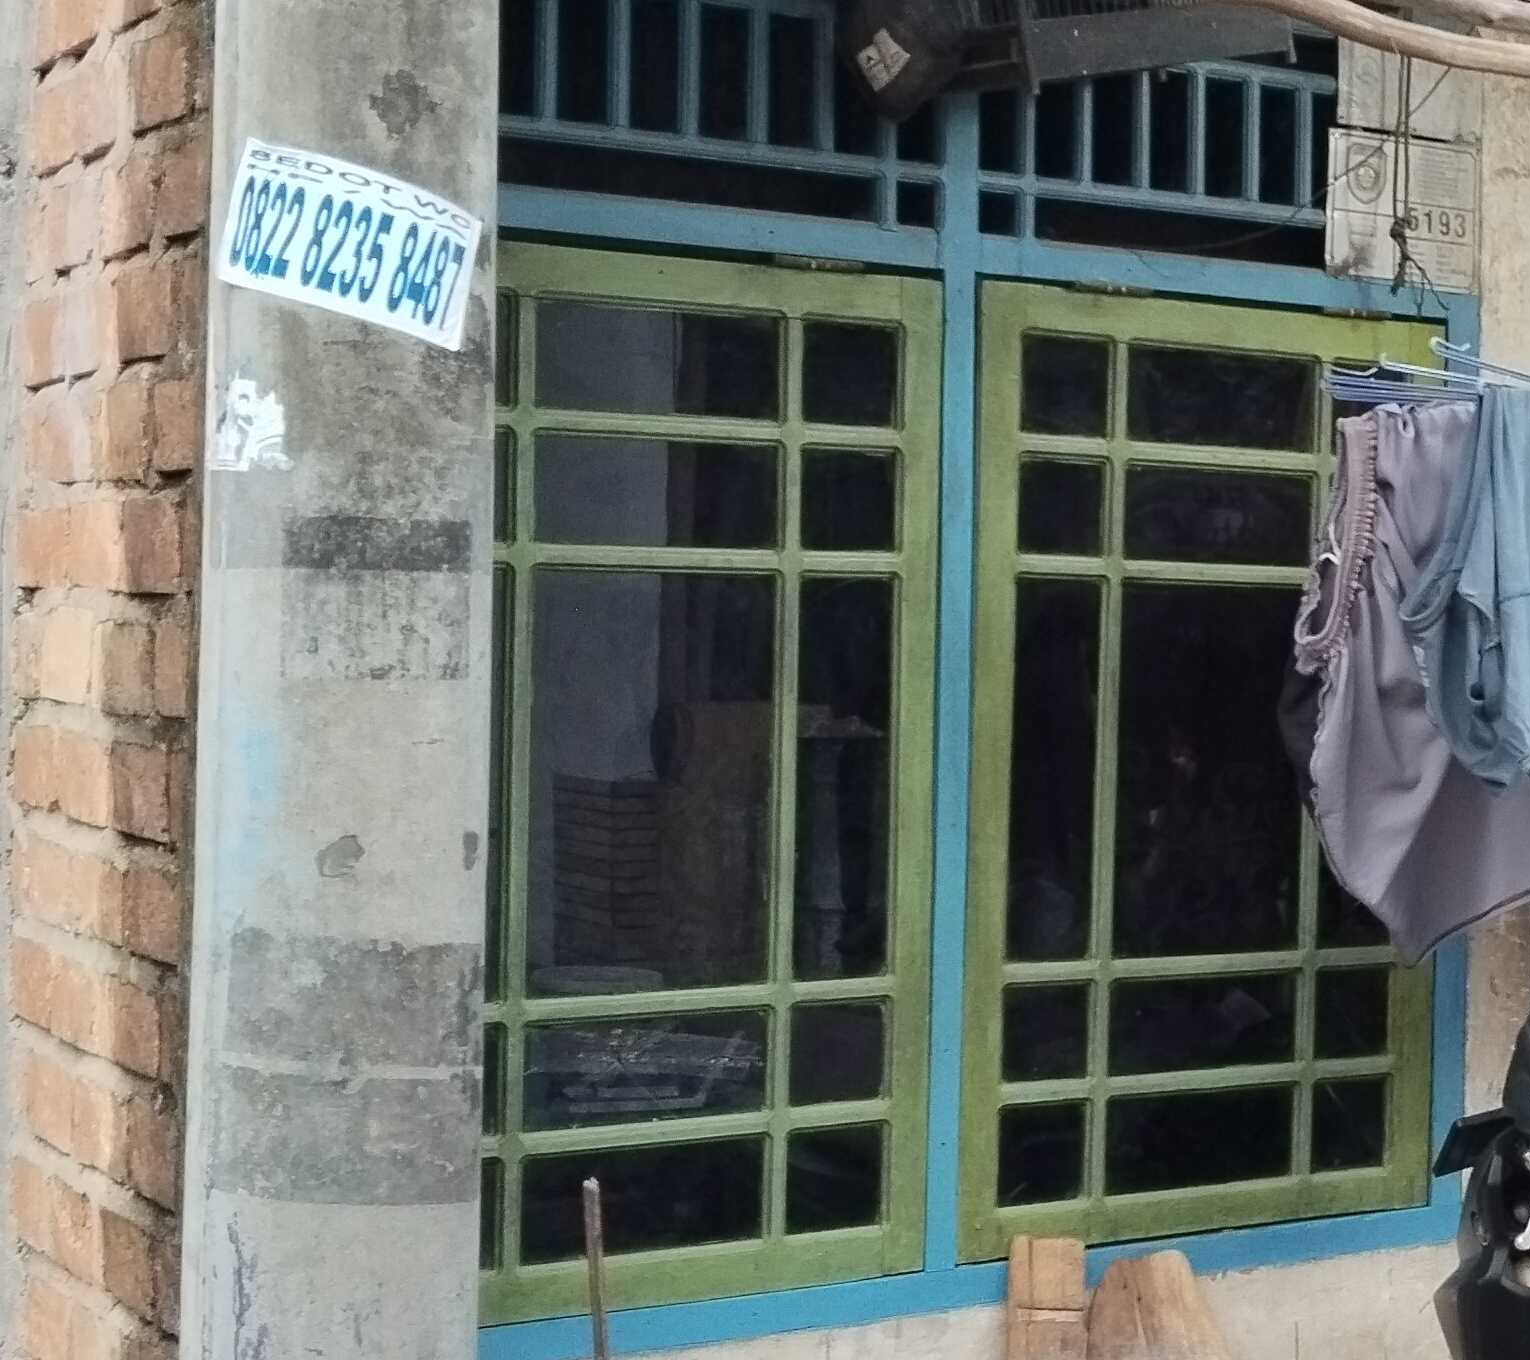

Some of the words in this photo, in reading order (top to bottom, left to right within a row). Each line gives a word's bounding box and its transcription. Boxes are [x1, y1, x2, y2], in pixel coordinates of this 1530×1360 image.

[228, 176, 305, 280] 0822
[300, 194, 395, 303] 8235
[386, 222, 467, 332] 8487
